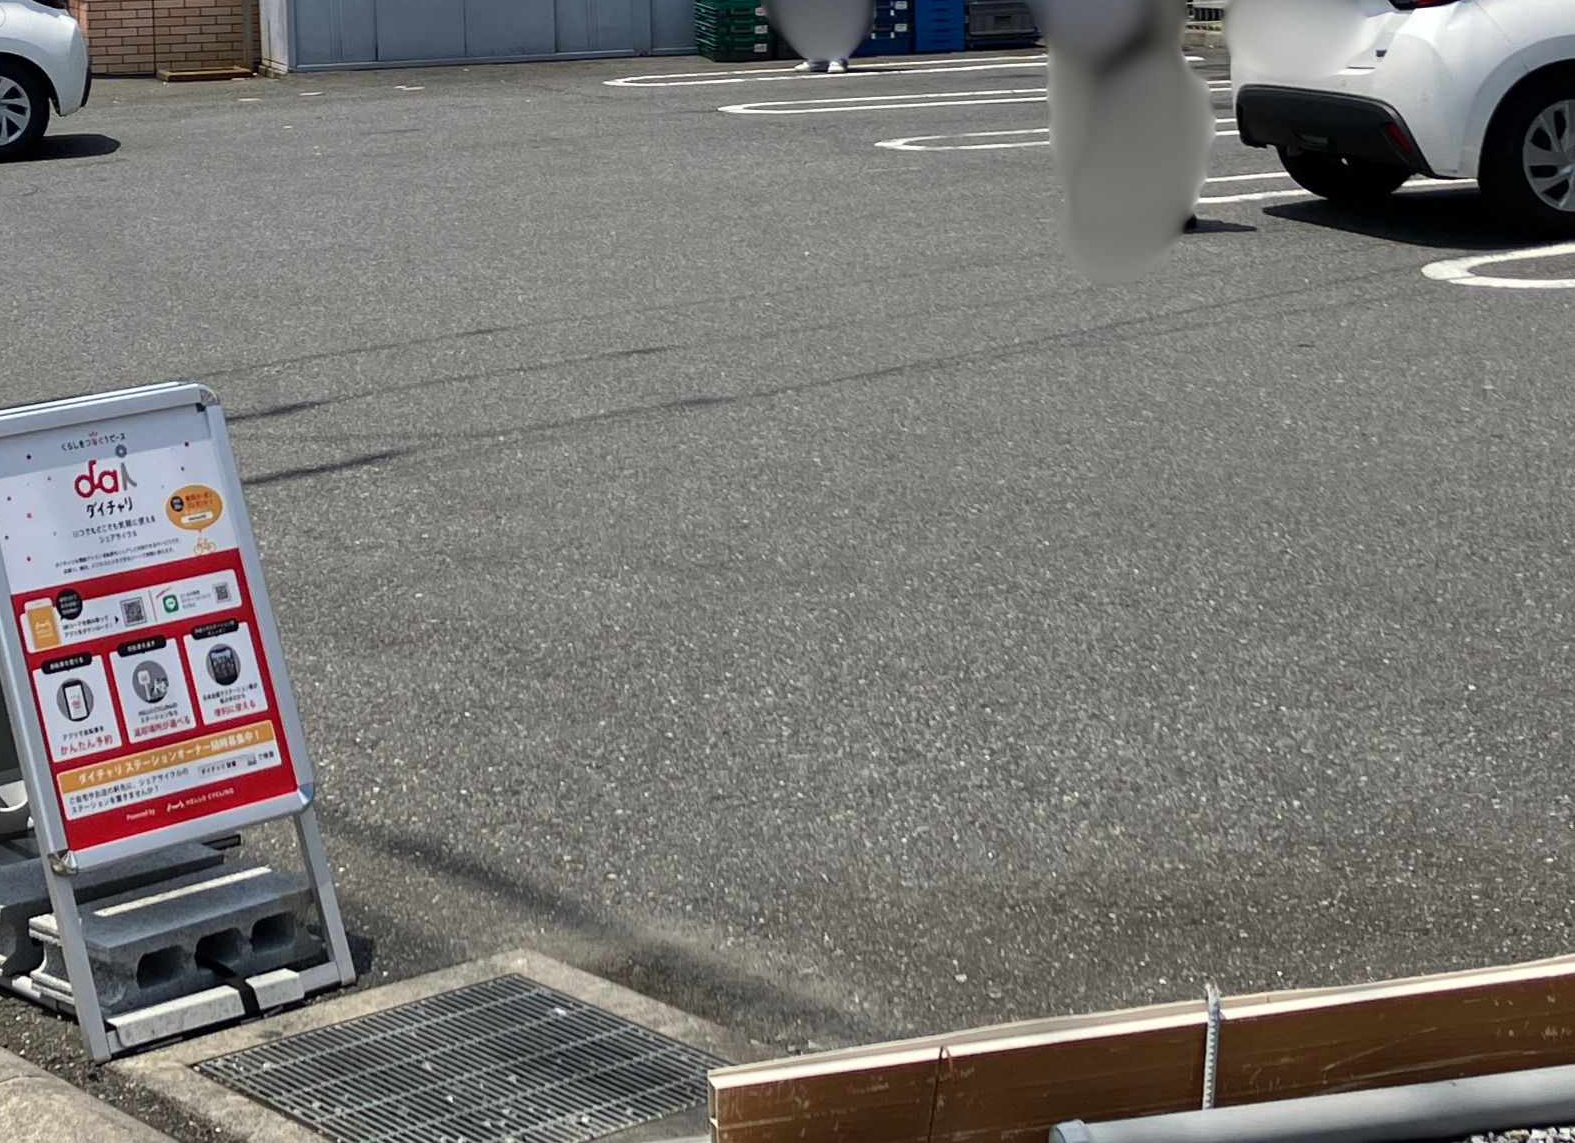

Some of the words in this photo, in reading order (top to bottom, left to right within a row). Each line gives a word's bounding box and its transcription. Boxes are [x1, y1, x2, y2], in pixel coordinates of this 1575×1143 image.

[85, 496, 133, 519] ダイチャリ
[78, 764, 123, 785] ダイチャリ
